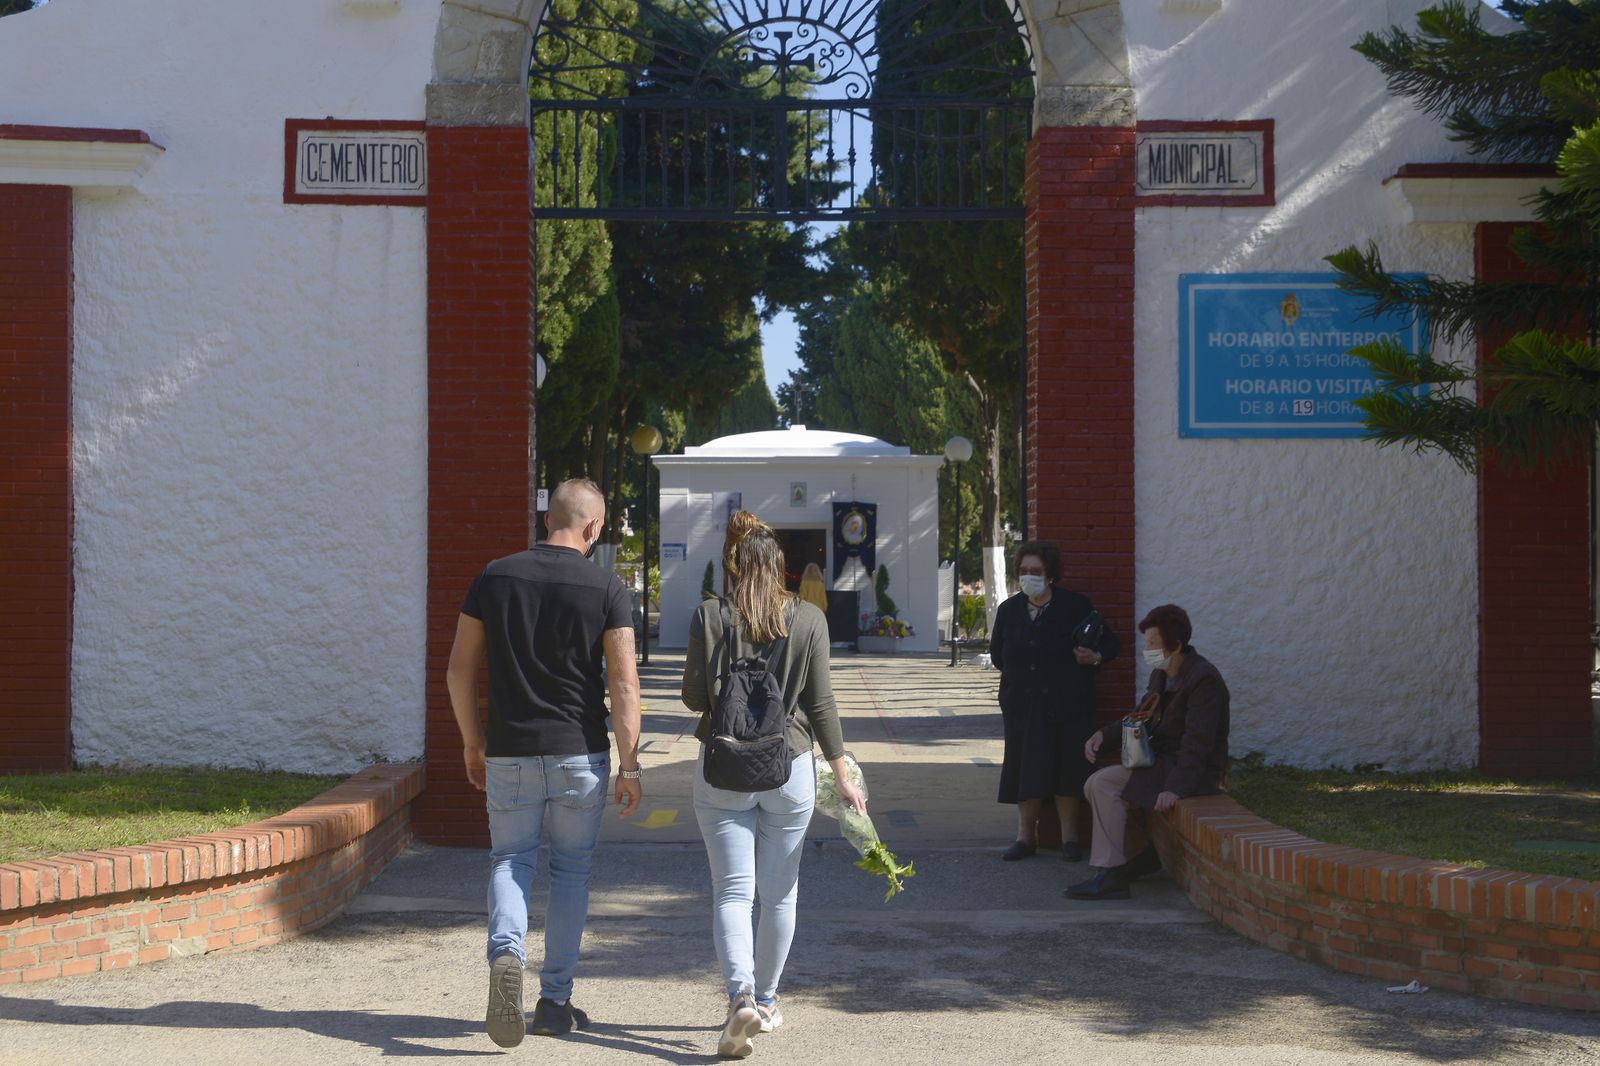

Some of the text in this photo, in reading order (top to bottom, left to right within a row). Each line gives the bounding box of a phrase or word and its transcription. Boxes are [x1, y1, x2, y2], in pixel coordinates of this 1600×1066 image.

[307, 143, 418, 184] CEMENTERIO
[1208, 332, 1295, 348] HORARIO
[1240, 353, 1371, 368] DE 9 A 15 HORA
[1226, 379, 1312, 394] HORARIO
[1240, 401, 1261, 415] DE
[1265, 401, 1274, 415] 8
[1278, 401, 1289, 415] A
[1295, 400, 1313, 415] 19
